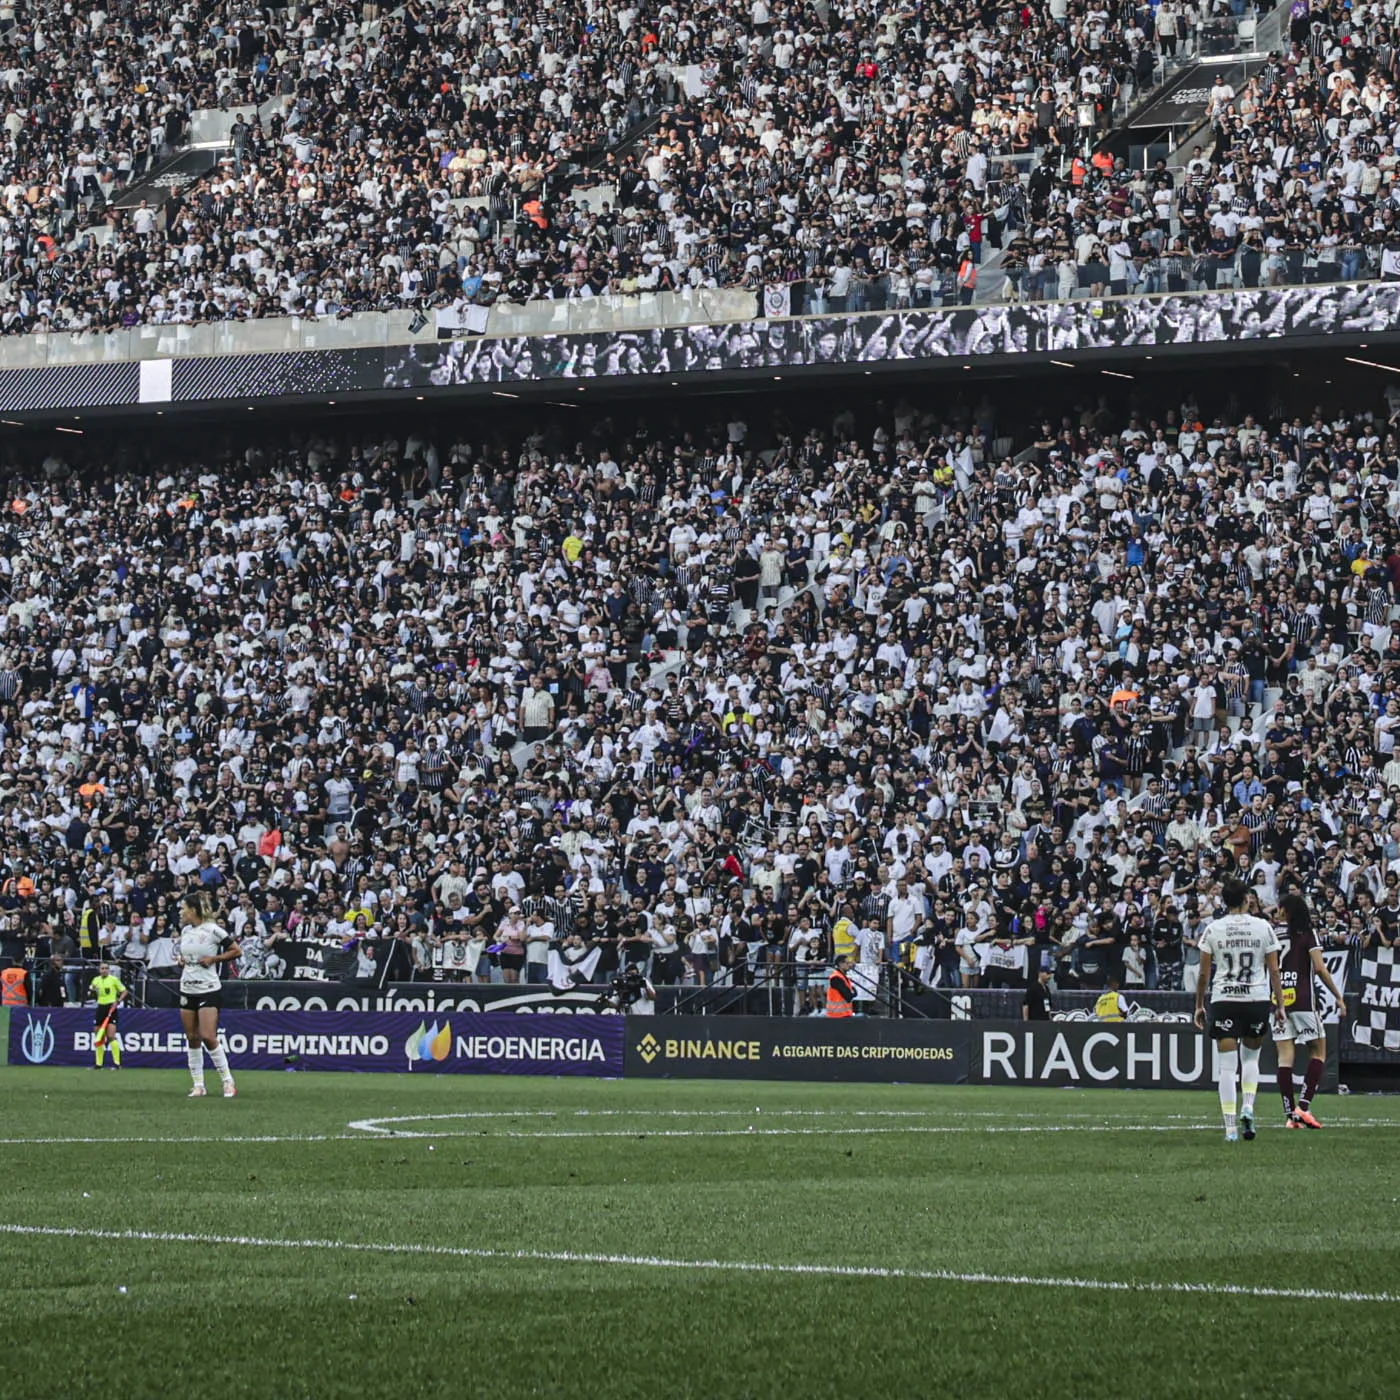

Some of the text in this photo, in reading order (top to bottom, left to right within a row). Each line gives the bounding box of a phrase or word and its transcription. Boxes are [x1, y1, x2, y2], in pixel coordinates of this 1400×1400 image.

[1226, 938, 1261, 949] PORTILHO
[252, 1034, 390, 1056] FEMININO
[456, 1036, 605, 1062] NEOENERGIA
[666, 1039, 761, 1061] BINANCE
[772, 1045, 954, 1060] A GIGANTE DAS CRIPTOMOEDAS
